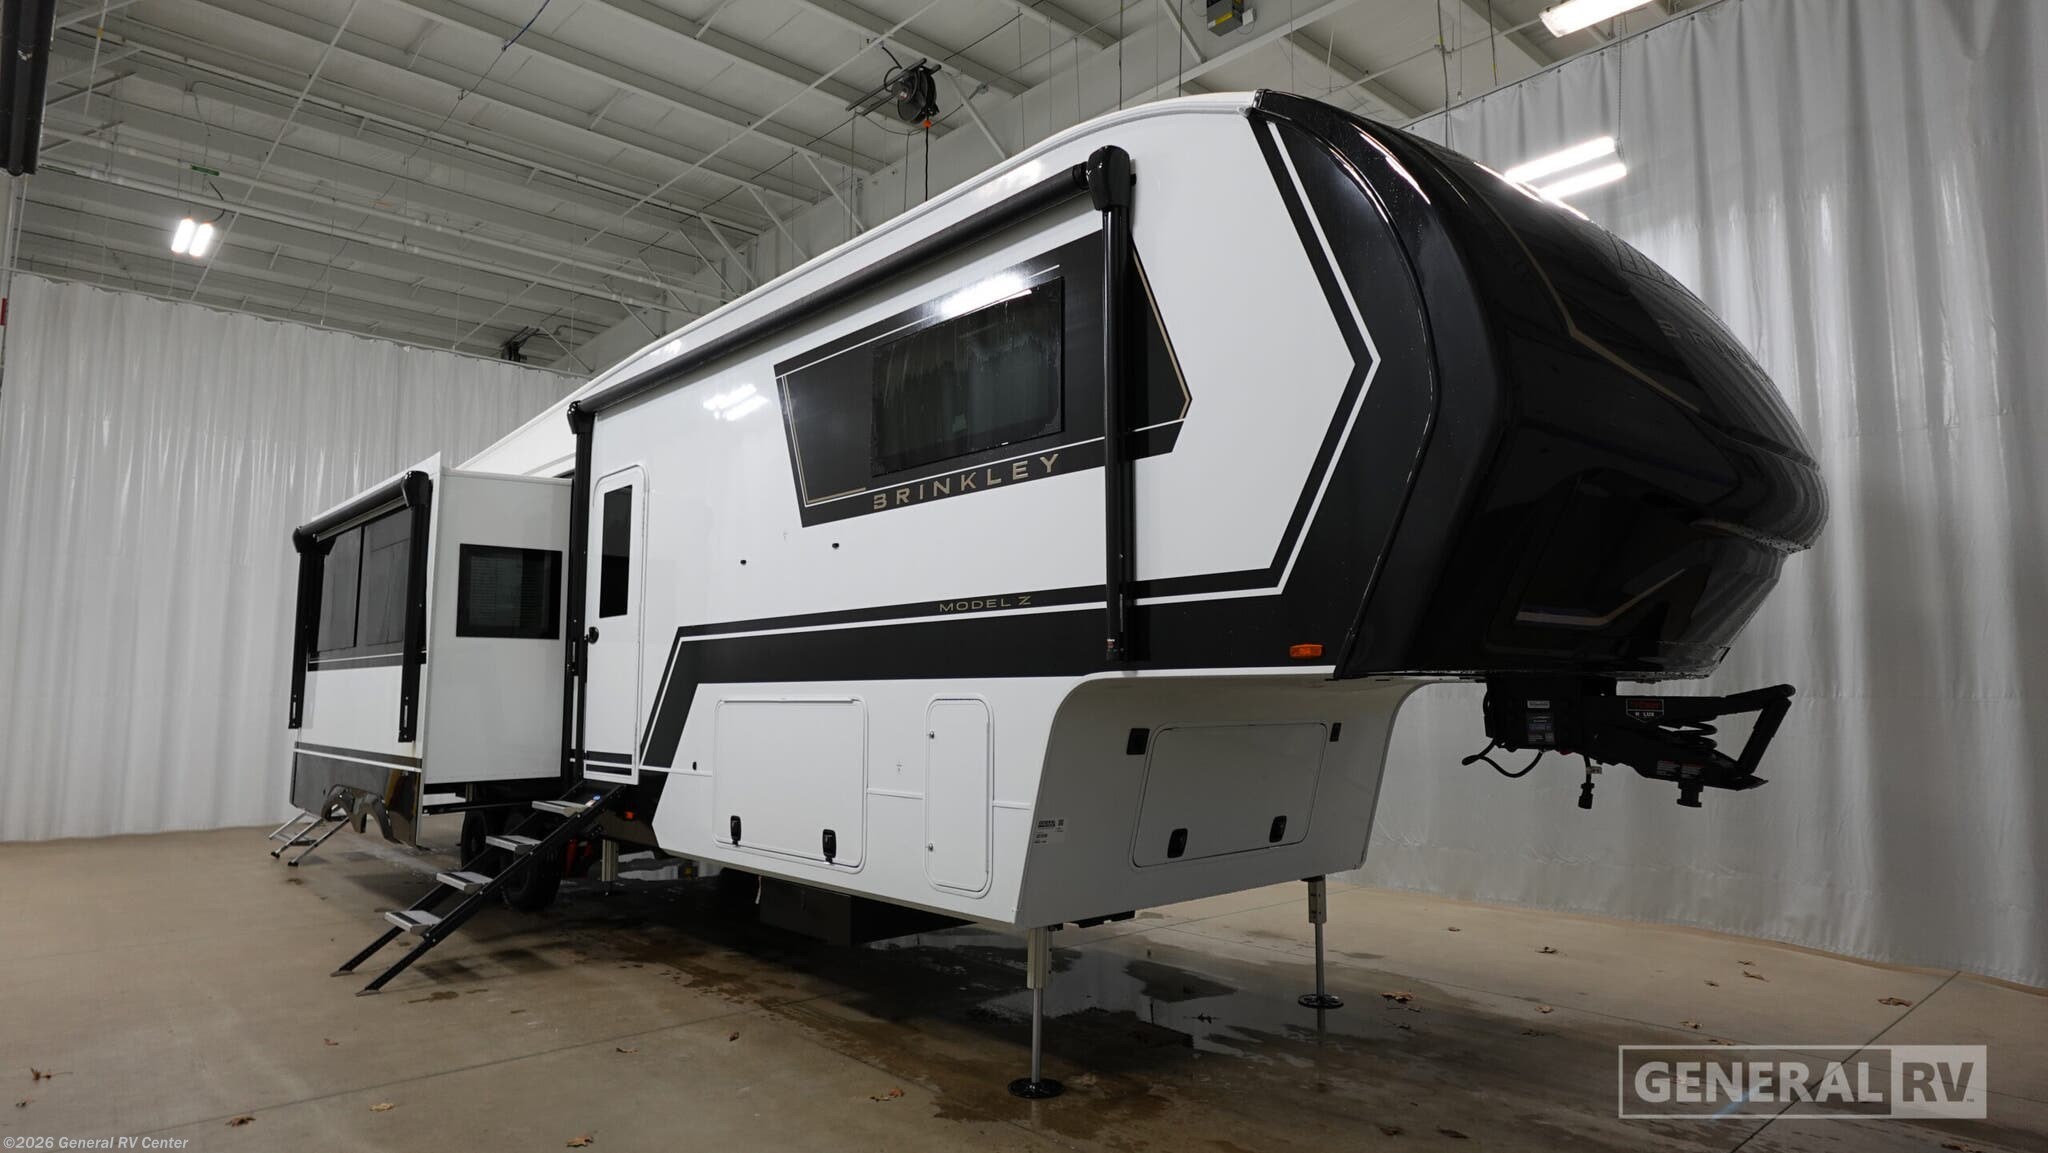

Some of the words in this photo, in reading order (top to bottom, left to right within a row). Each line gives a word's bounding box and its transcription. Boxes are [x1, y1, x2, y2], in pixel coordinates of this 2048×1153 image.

[873, 453, 1060, 510] BRINKLEY
[939, 598, 1012, 613] MODEL
[1018, 595, 1032, 606] Z
